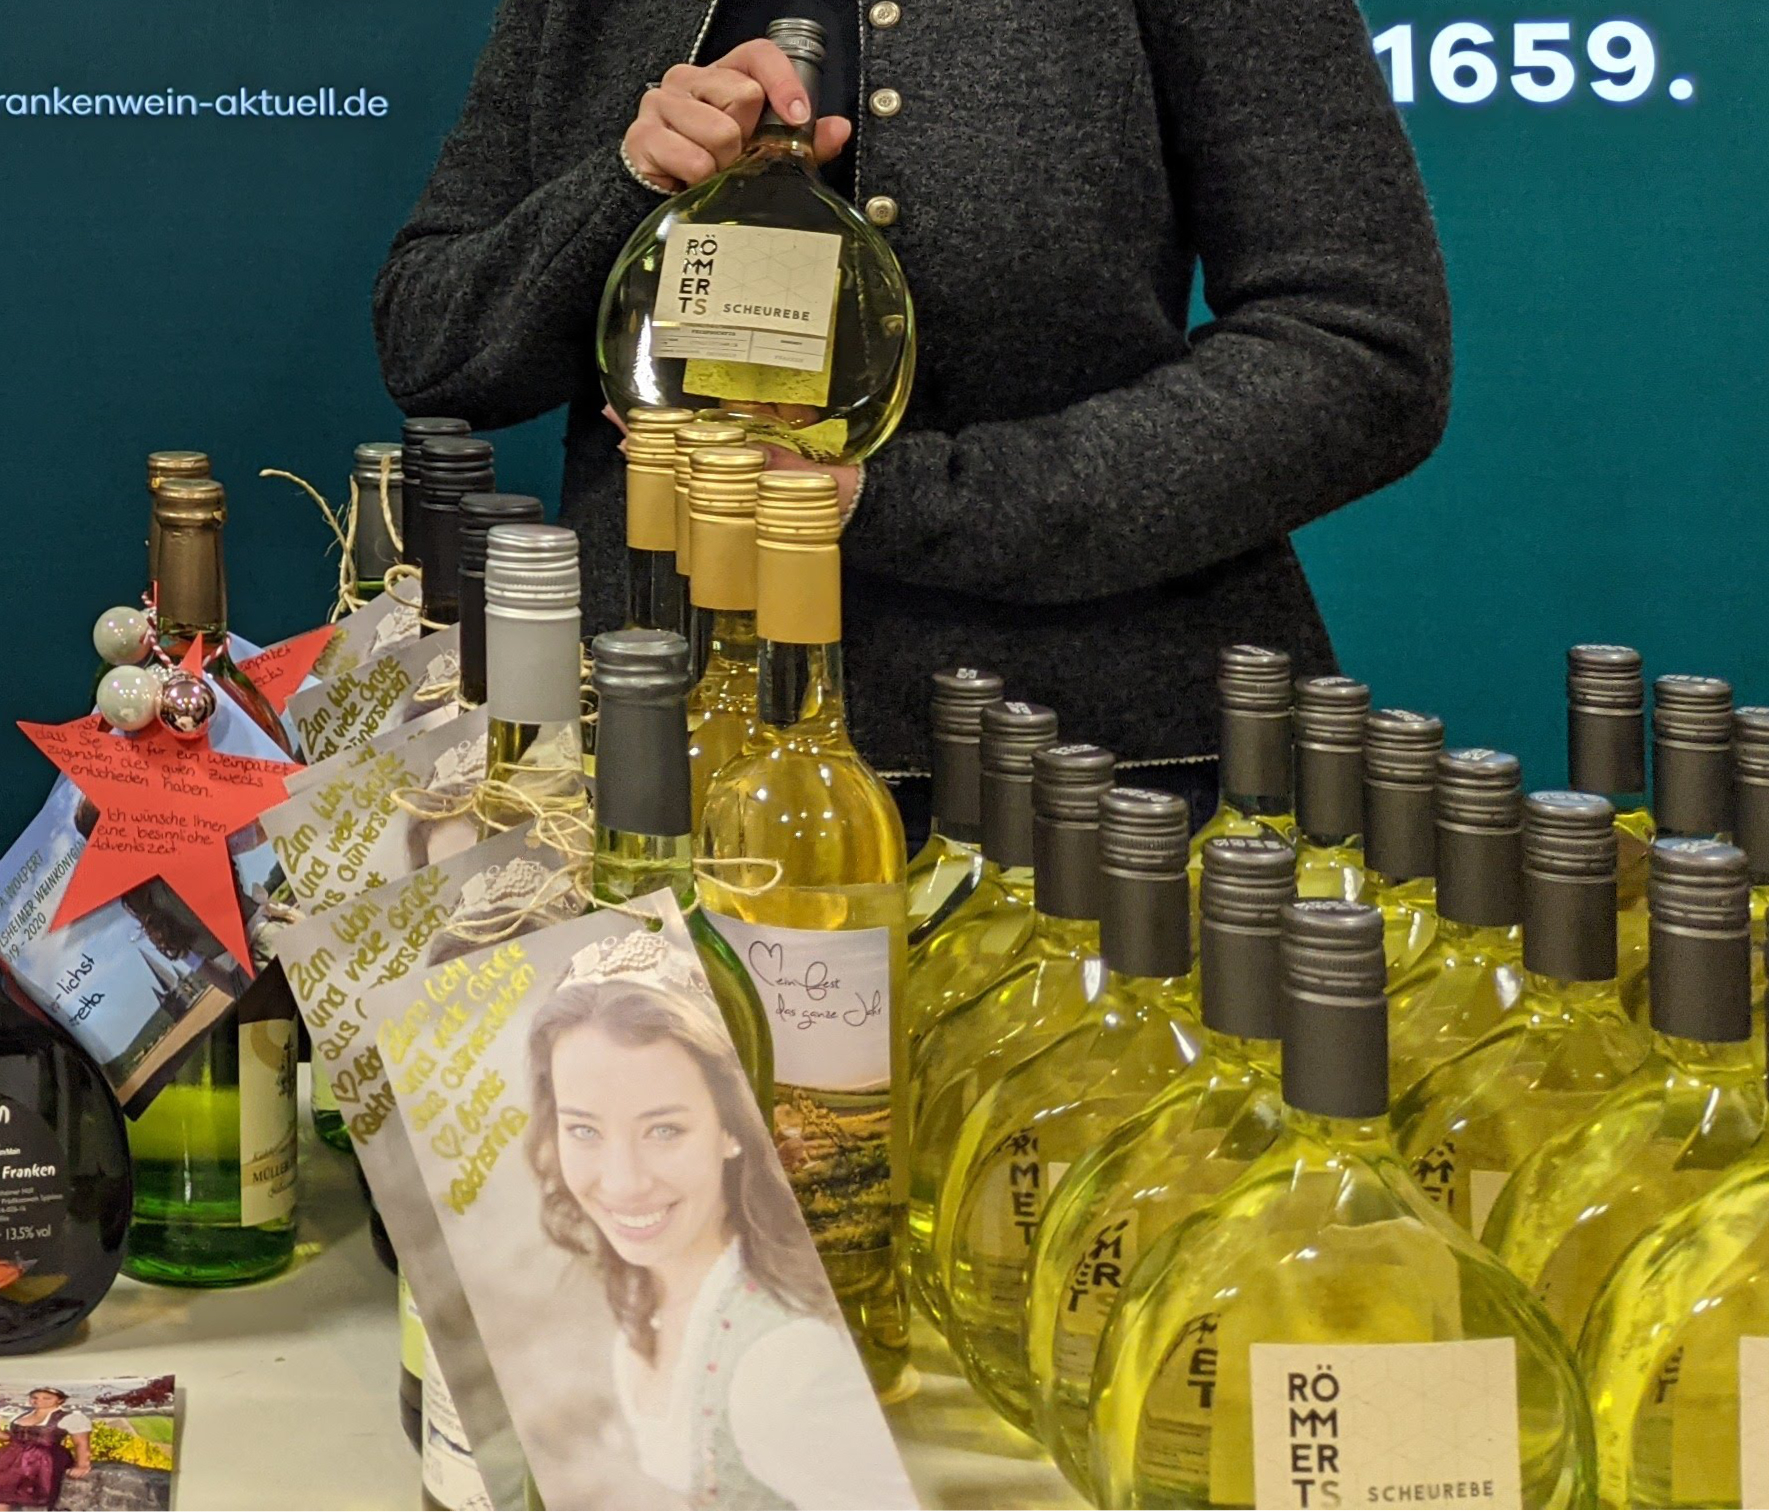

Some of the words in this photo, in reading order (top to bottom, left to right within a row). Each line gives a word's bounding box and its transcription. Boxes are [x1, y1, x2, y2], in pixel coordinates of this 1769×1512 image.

[1373, 20, 1694, 104] 1659.
[723, 303, 810, 321] SCHEUREBE
[298, 707, 332, 756] Zum
[47, 744, 113, 766] zugunsten
[162, 764, 197, 780] guten
[79, 731, 101, 748] Sie
[114, 737, 141, 754] sich
[146, 741, 167, 756] für
[177, 747, 200, 761] ein
[207, 752, 290, 776] Weinpaket
[71, 764, 150, 787] entschieden
[163, 777, 214, 799] haben.
[97, 823, 127, 839] eine
[137, 826, 215, 846] besinnliche
[106, 807, 127, 823] Ich
[130, 810, 189, 828] wünsche
[193, 813, 228, 833] Ihnen
[272, 822, 318, 875] Zum
[4, 848, 44, 899] WOLPERT
[23, 910, 47, 942] 2020
[288, 946, 337, 1002] Zum
[305, 982, 349, 1029] und
[775, 992, 797, 1023] das
[801, 1007, 839, 1030] ganze
[1, 1163, 56, 1180] Franken
[35, 1224, 52, 1237] vol
[1368, 1480, 1494, 1503] SCHEUREBE
